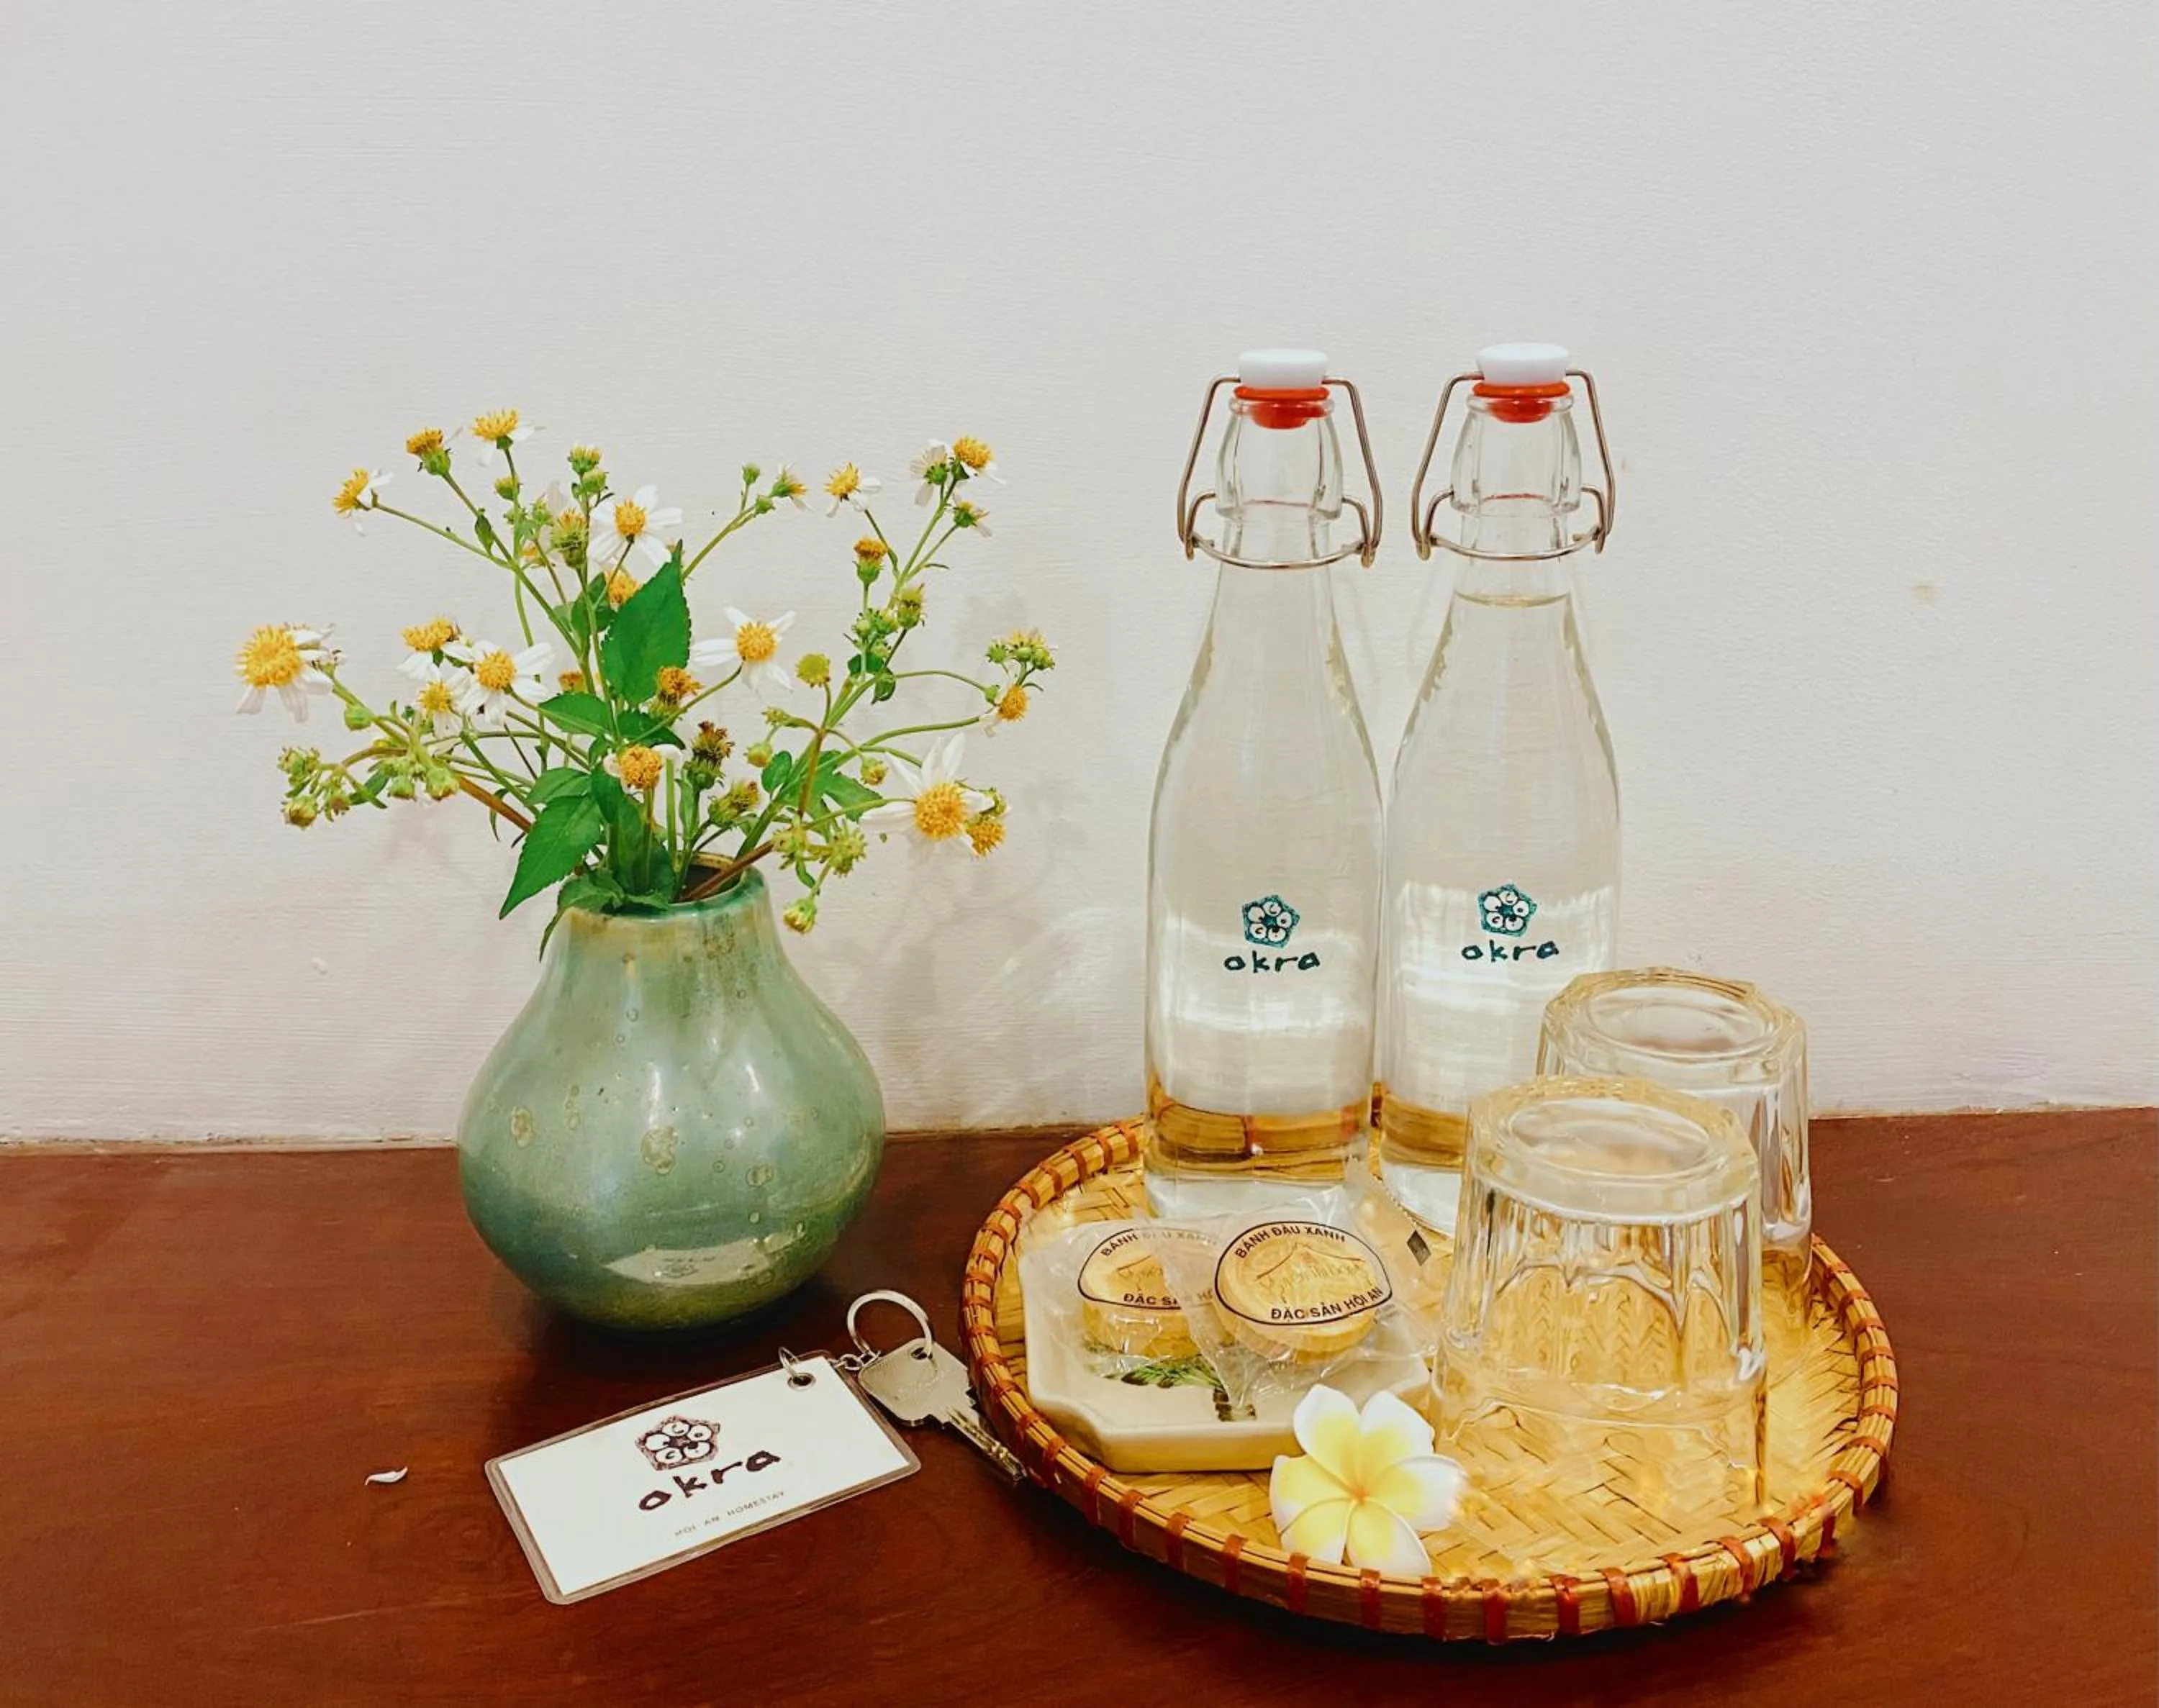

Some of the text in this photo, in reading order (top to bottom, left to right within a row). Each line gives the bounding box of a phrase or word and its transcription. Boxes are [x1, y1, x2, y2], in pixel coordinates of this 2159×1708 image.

[1223, 951, 1321, 973] okra
[1462, 939, 1560, 963] okra
[1304, 1227, 1346, 1243] XANH
[1367, 1286, 1384, 1302] AN
[638, 1450, 782, 1511] okra
[705, 1515, 720, 1526] AN
[727, 1491, 784, 1517] HOMESTAY
